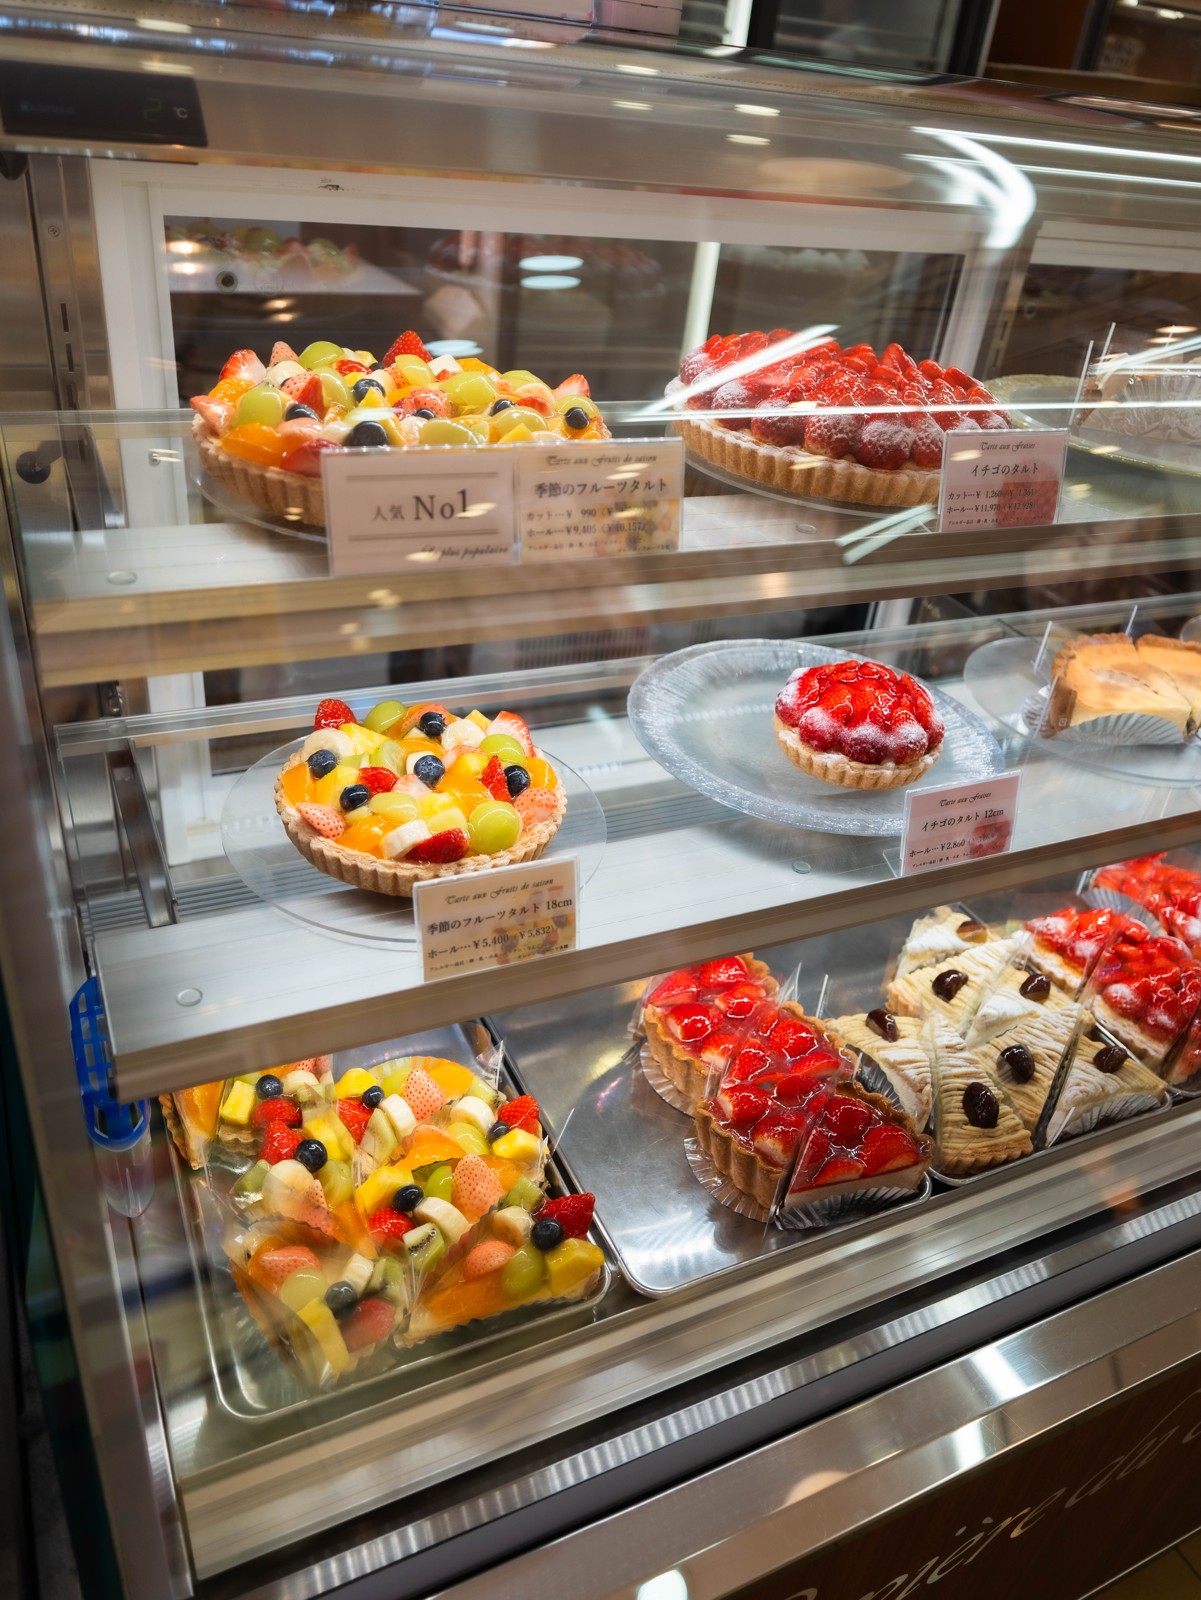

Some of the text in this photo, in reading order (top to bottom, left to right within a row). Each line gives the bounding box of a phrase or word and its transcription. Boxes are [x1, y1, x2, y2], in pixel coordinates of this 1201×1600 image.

[971, 463, 1039, 477] イチゴのタルト
[534, 478, 667, 498] 季節のフルーツタルト
[371, 504, 405, 521] 人気
[922, 809, 1004, 832] イチゴのタルト 12cm
[490, 886, 518, 899] Fruits
[521, 881, 530, 890] de
[532, 878, 554, 888] saison
[427, 898, 573, 936] 季節のフルーツタルト 18cm
